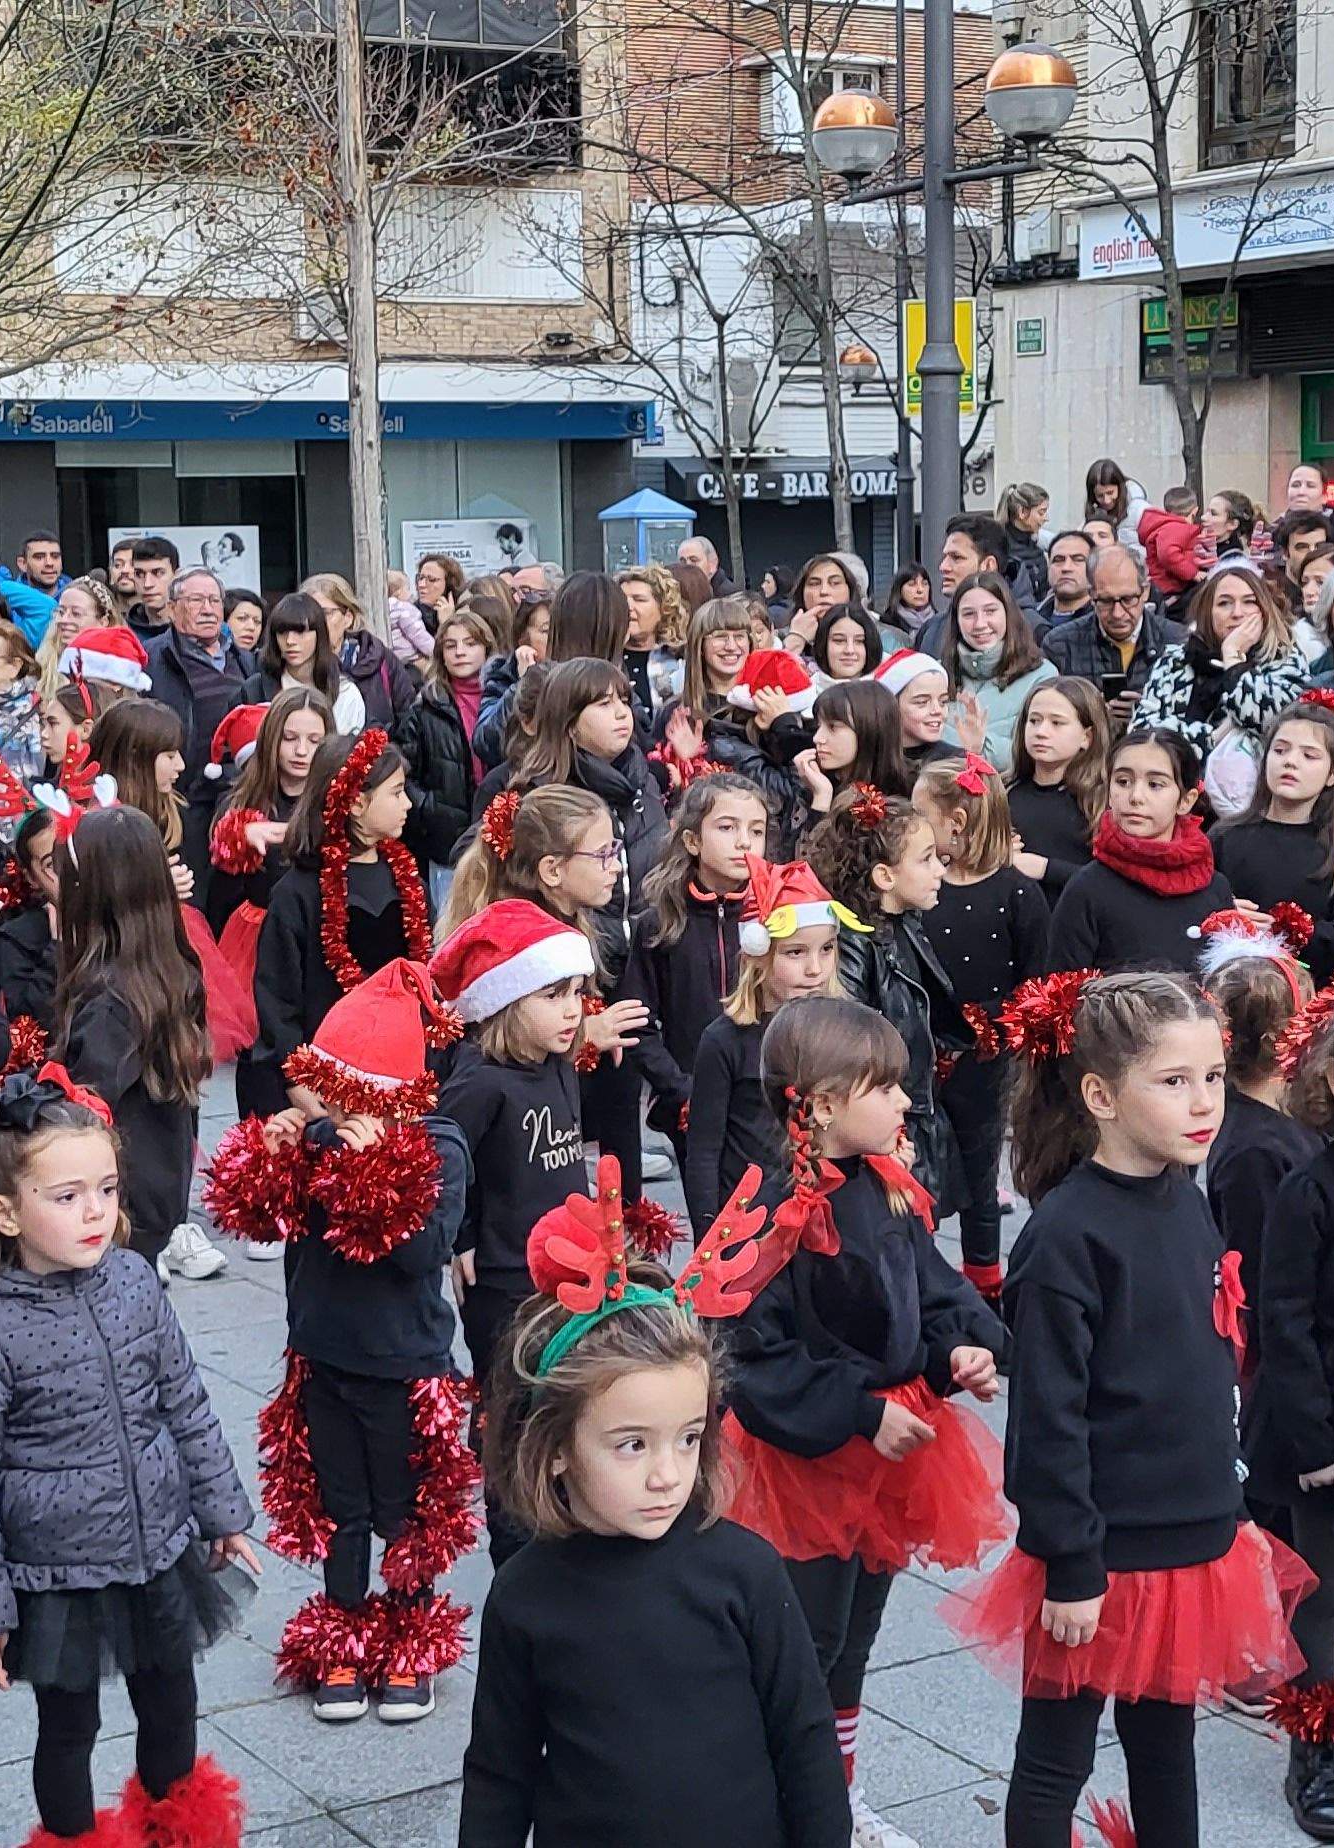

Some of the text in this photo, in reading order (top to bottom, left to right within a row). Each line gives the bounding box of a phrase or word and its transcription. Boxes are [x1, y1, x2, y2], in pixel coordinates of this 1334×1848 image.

[1093, 237, 1133, 273] english
[908, 376, 973, 393] OE
[30, 414, 114, 433] Sabadell
[328, 414, 404, 433] Saell
[696, 473, 760, 498] CAE
[781, 472, 830, 498] BAR
[539, 1147, 568, 1172] TOO
